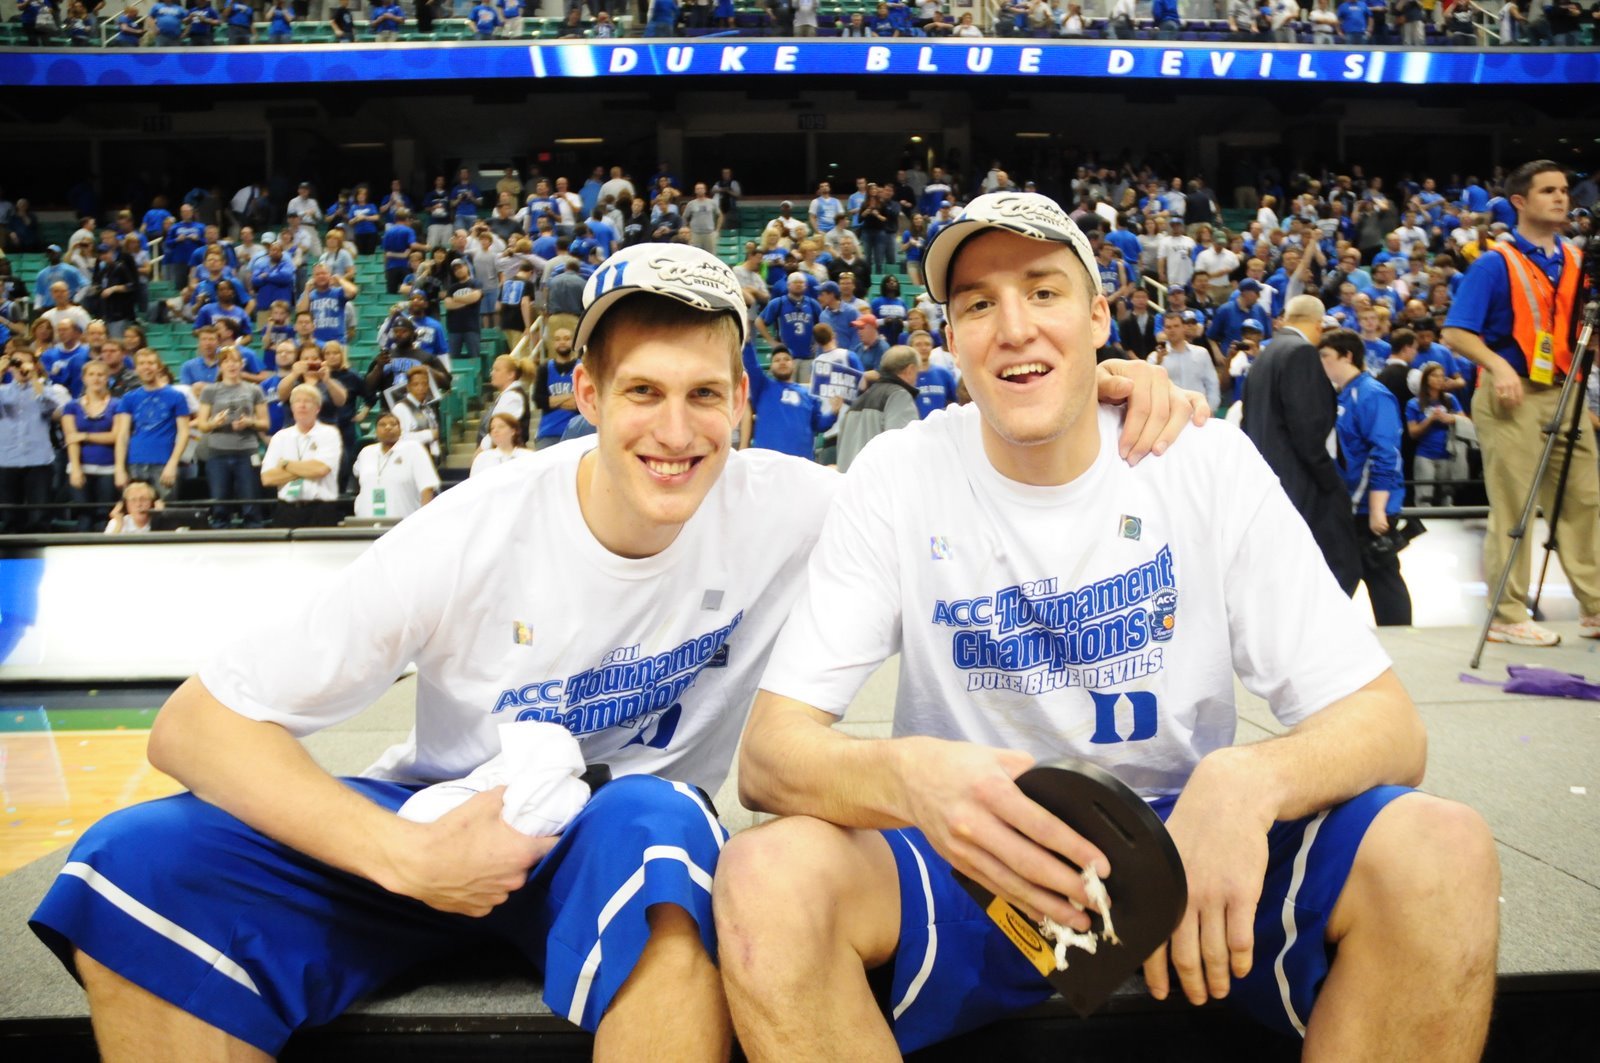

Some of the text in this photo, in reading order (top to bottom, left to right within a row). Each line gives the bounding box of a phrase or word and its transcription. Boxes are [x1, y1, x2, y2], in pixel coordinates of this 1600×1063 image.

[609, 45, 1365, 80] DUKE BLUE DEVILS
[693, 278, 720, 290] 2011
[784, 311, 810, 323] DUKE
[794, 322, 805, 334] 3
[815, 361, 831, 376] GO
[549, 382, 573, 396] DUK
[932, 543, 1175, 634] ACC Tournament
[1021, 577, 1058, 597] 2011
[1156, 594, 1175, 605] ACC
[952, 608, 1149, 672] Champions
[600, 643, 641, 666] 2011
[967, 648, 1163, 695] DUKE BLUE DEVILS
[491, 679, 563, 713] ACC
[514, 671, 702, 736] Champion
[1088, 690, 1158, 745] D
